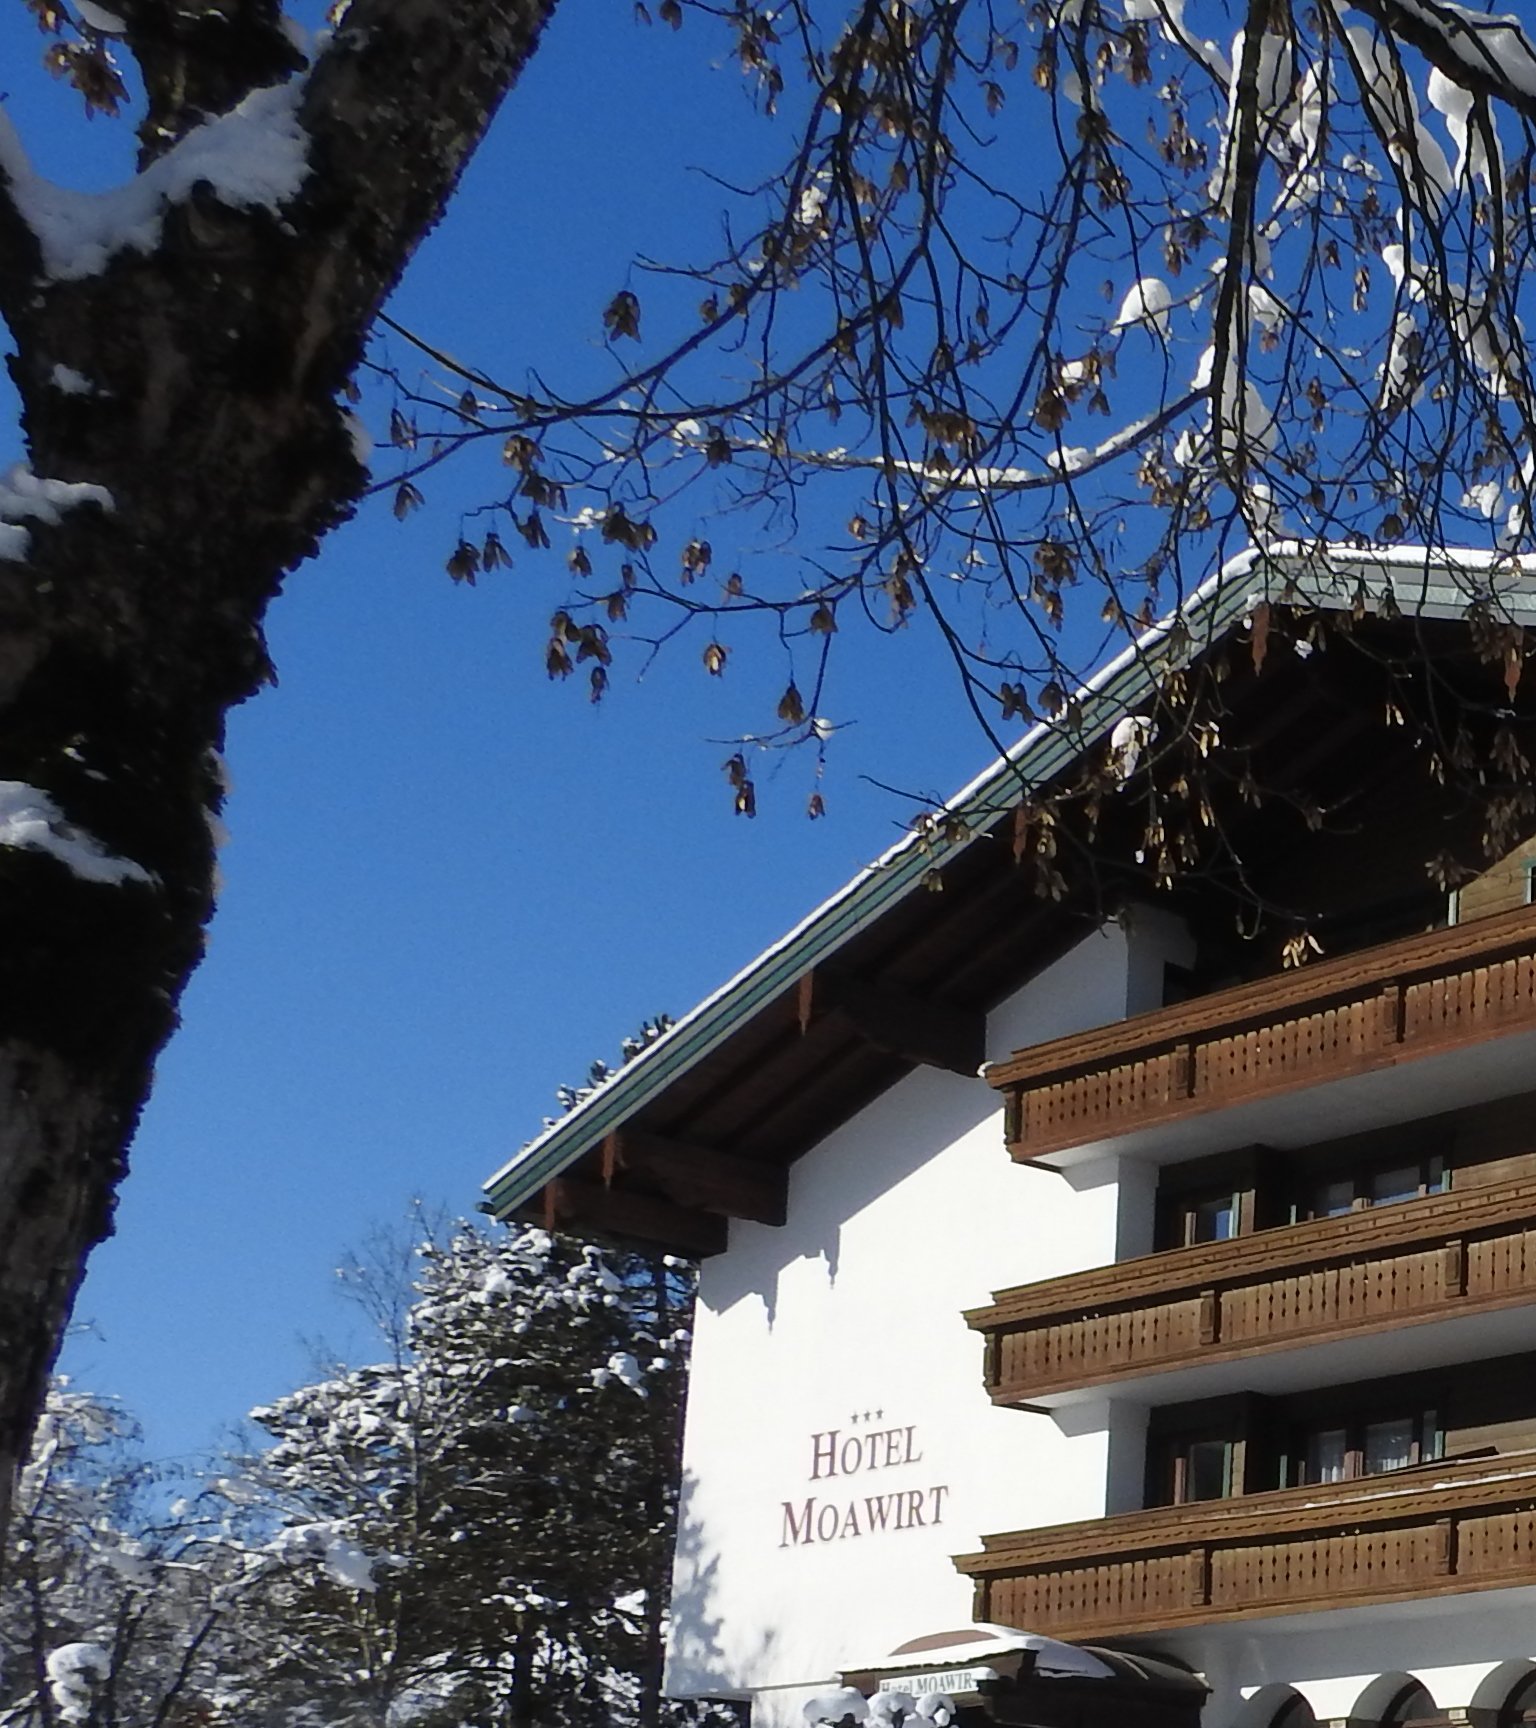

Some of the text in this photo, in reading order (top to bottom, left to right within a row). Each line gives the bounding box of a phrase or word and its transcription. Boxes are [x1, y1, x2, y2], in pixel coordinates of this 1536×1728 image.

[809, 1425, 922, 1480] HOTEL
[779, 1486, 948, 1547] MOAWIRT
[916, 1672, 976, 1694] MOAWIR
